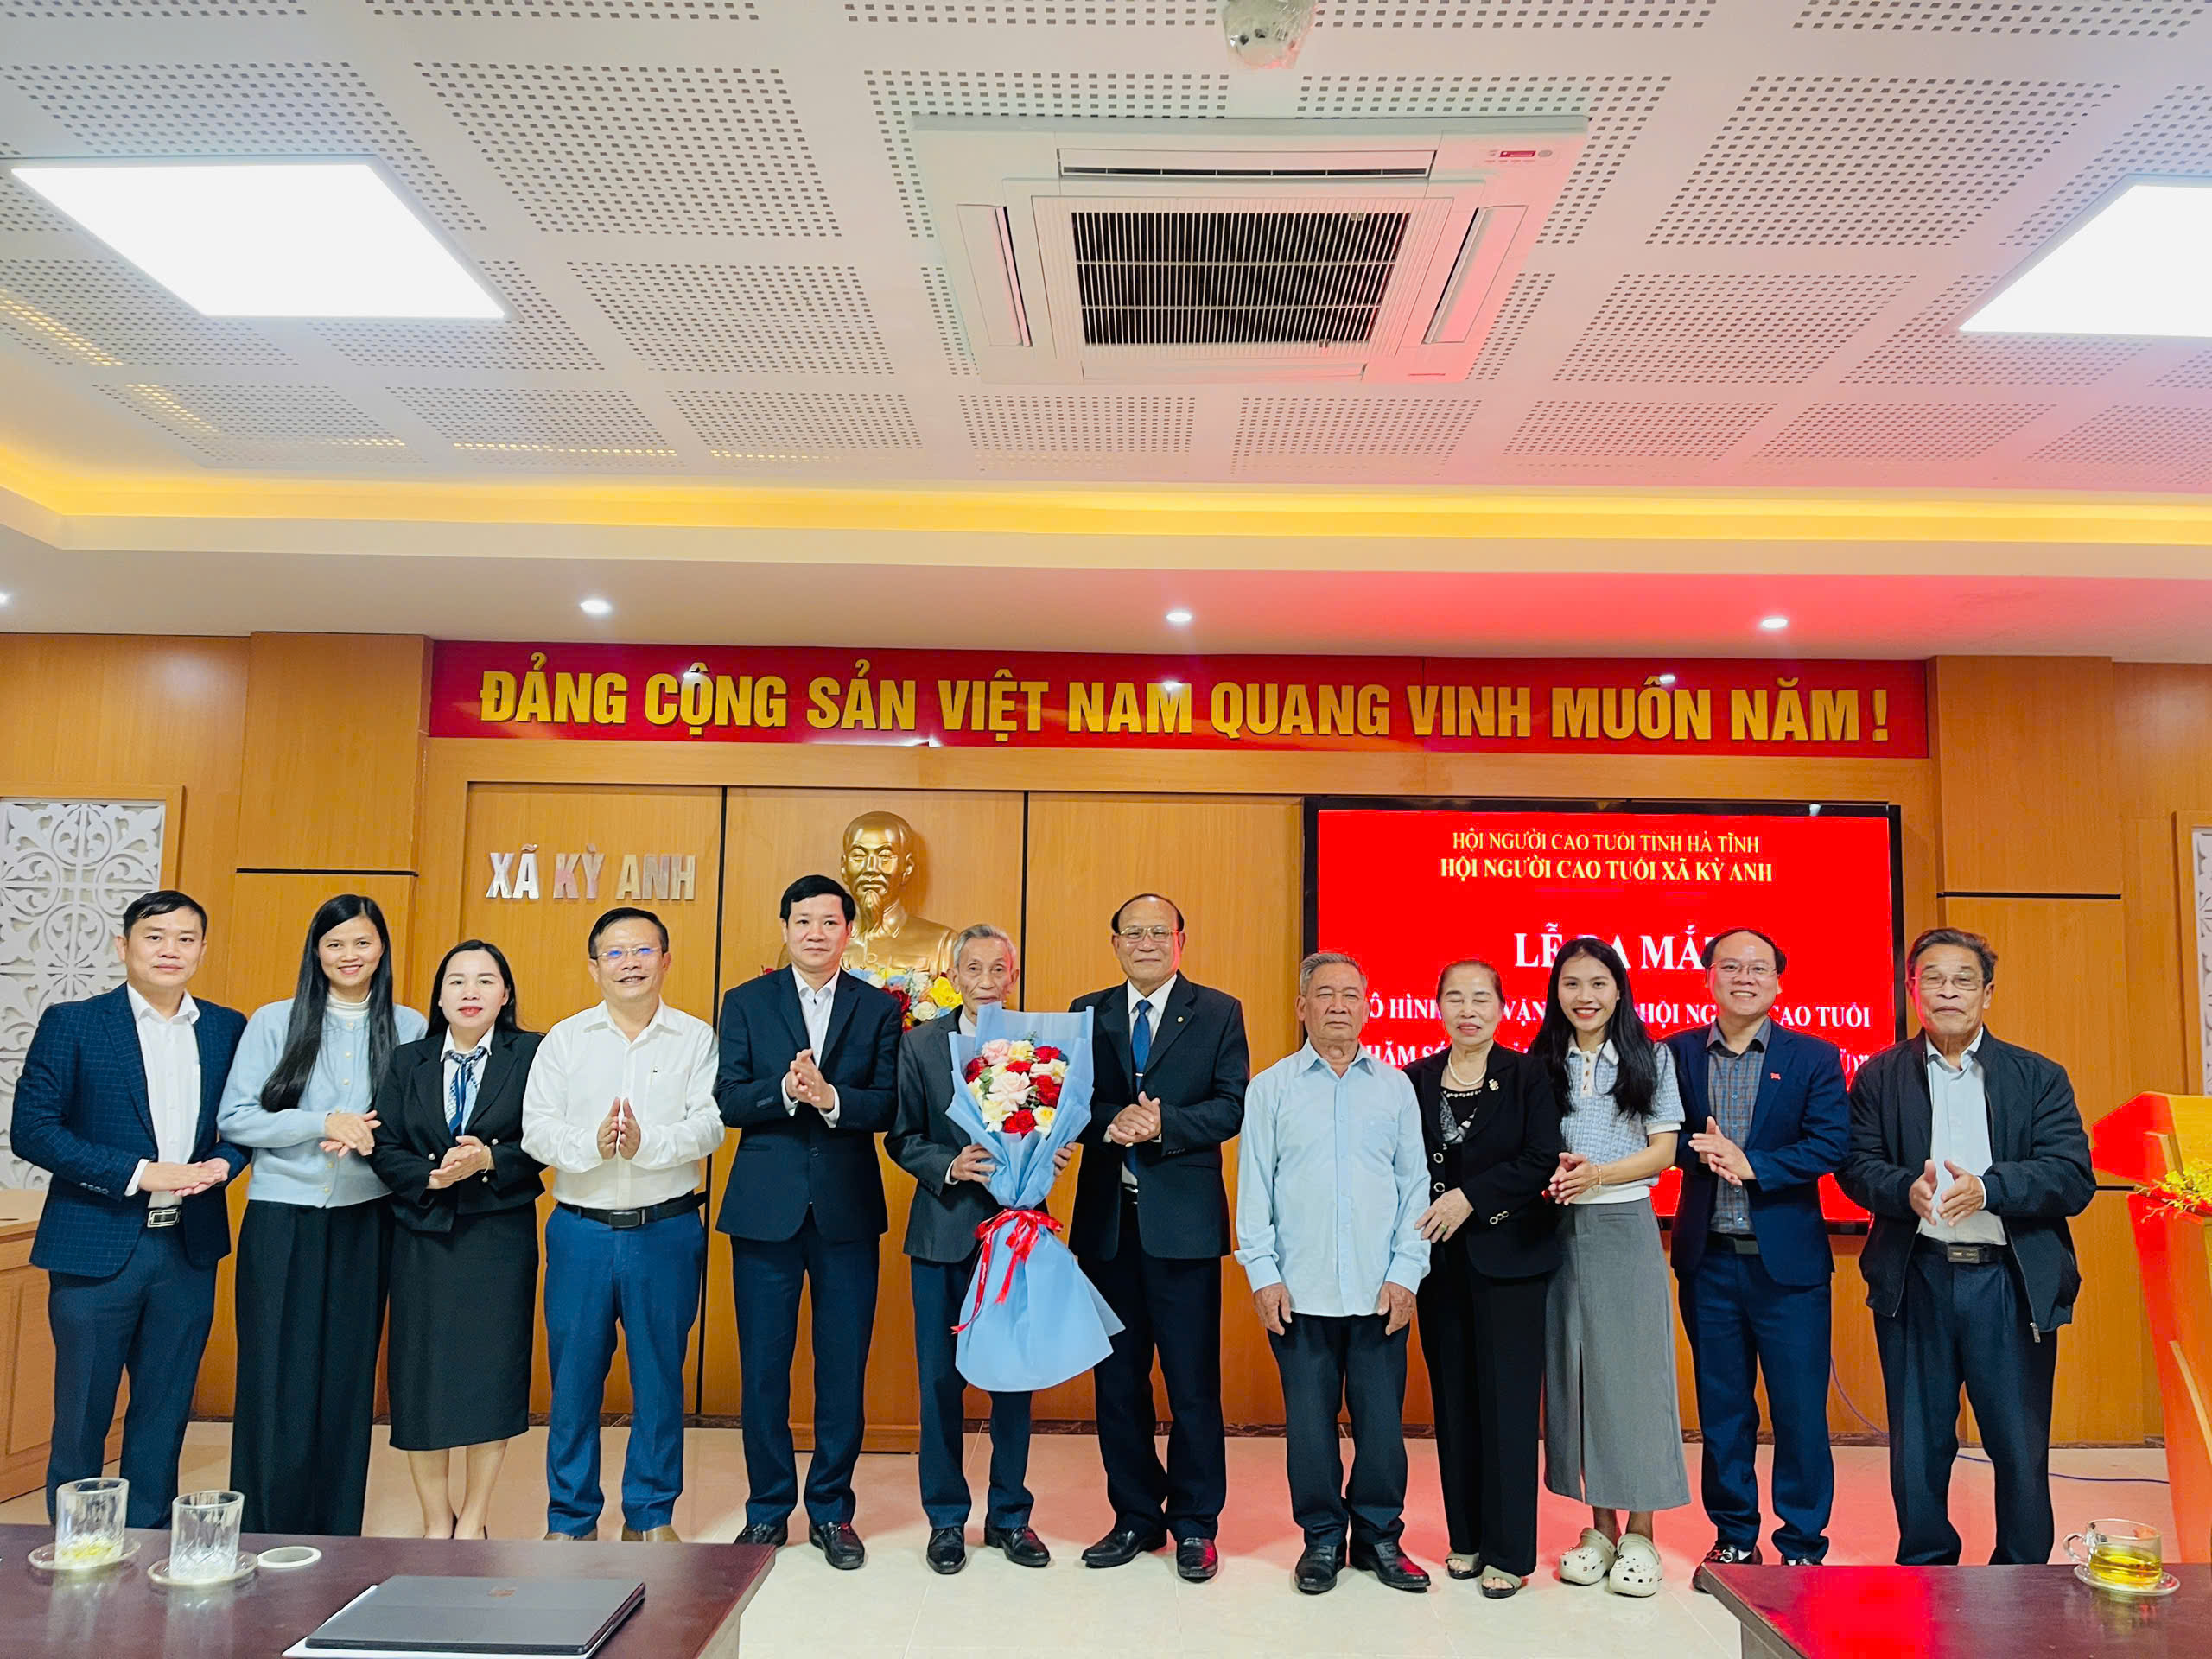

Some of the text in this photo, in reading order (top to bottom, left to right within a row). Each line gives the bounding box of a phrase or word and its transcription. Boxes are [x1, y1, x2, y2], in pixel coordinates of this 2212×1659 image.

[480, 652, 628, 725] ĐẢNG
[645, 662, 787, 735] CỘNG
[806, 659, 916, 731] SẢN
[938, 668, 1049, 742] VIỆT
[1068, 681, 1192, 734] NAM
[1211, 681, 1389, 739] QUANG
[1407, 685, 1531, 738] VINH
[1552, 676, 1711, 741] MUÔN
[1731, 677, 1860, 741] NĂM
[1452, 827, 1484, 853] HỘI
[1489, 828, 1546, 850] NGƯỜI
[1551, 834, 1589, 851] CAO
[1688, 830, 1713, 853] HÀ
[486, 843, 696, 900] XÃ KỲ ANH
[1440, 855, 1478, 882] HỘI
[1484, 854, 1551, 879] NGƯỜI
[1557, 860, 1602, 880] CAO
[1662, 857, 1690, 881] XÃ
[1696, 856, 1725, 881] KỲ
[1729, 862, 1772, 883] ANH
[1640, 925, 1717, 970] MẮ
